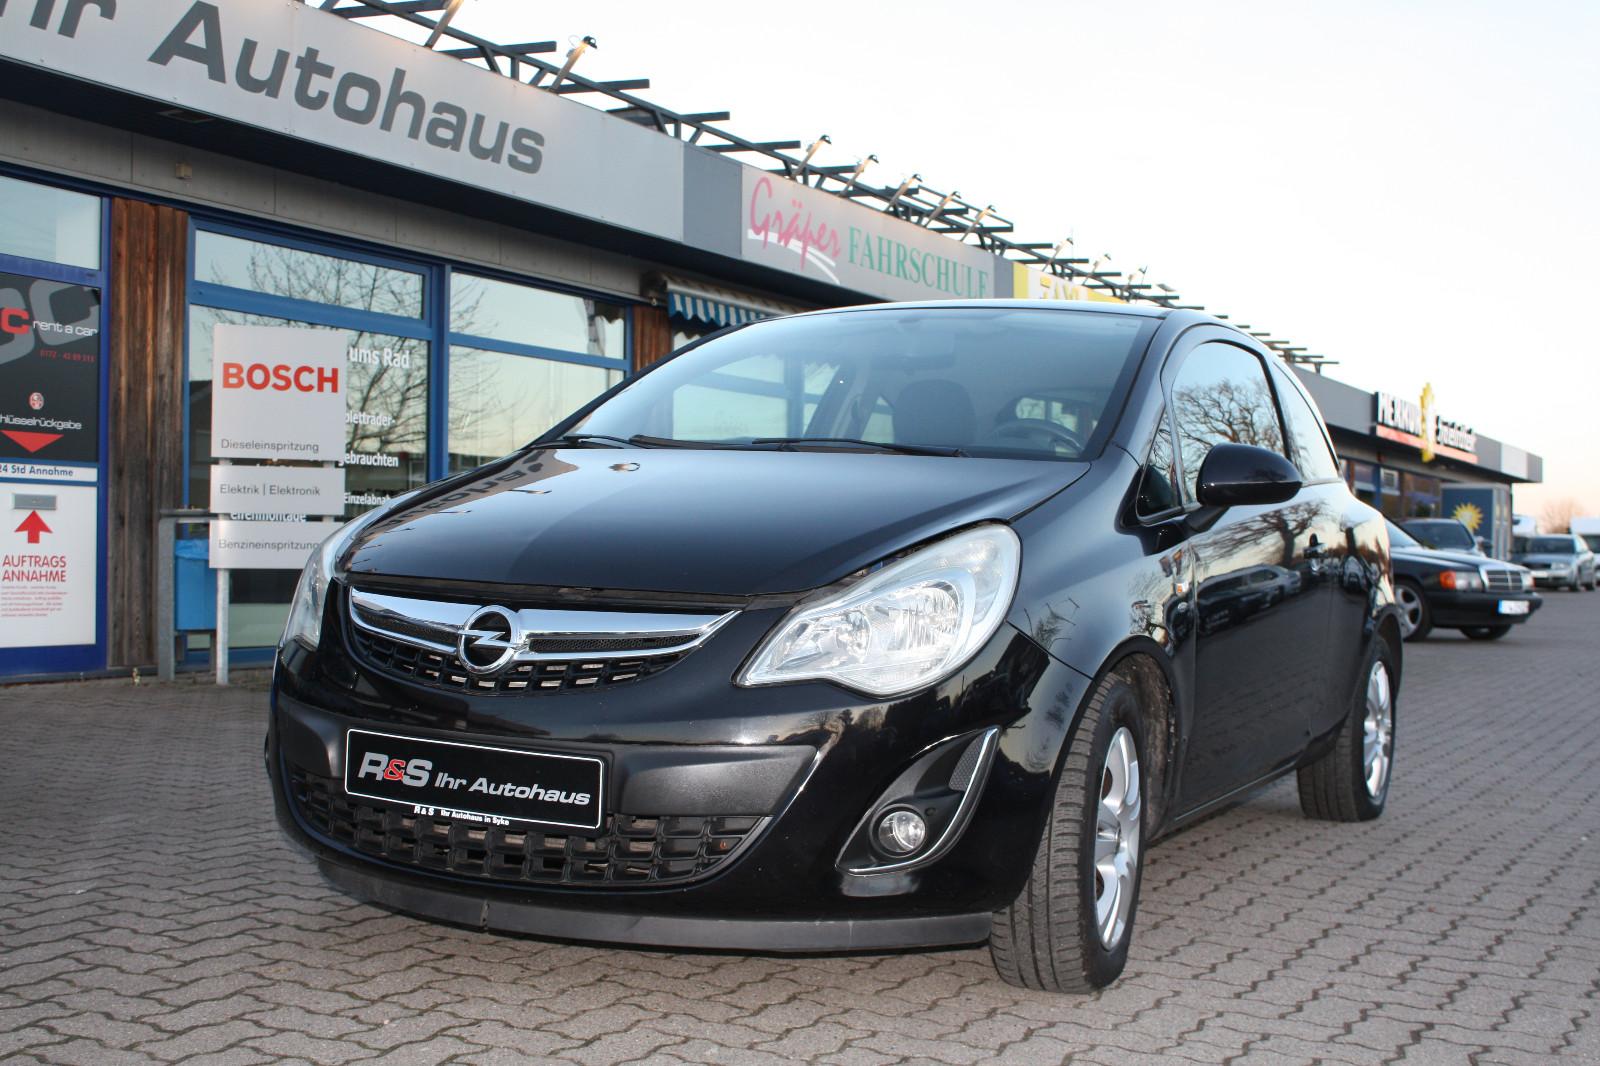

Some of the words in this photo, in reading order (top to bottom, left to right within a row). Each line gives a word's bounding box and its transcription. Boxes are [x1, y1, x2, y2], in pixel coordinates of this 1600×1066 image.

[147, 1, 545, 174] Autohaus
[750, 177, 841, 270] Gräper
[847, 226, 989, 299] FAHRSCHULE
[33, 319, 63, 333] rent
[64, 325, 73, 334] a
[75, 326, 98, 336] car
[349, 347, 380, 365] ums
[383, 347, 410, 368] Rad
[222, 362, 339, 393] BOSCH
[221, 438, 319, 454] Dieseleinspritzung
[338, 450, 399, 467] ebrauchten
[11, 464, 26, 474] Std
[30, 466, 74, 477] Annahme
[219, 484, 259, 495] Elektrik
[269, 485, 320, 496] Elektronik
[2, 554, 67, 569] AUFTRAGS
[2, 569, 67, 583] ANNAHME
[358, 751, 433, 788] R&S
[435, 771, 467, 790] Ihr
[468, 777, 591, 806] Autohaus
[413, 805, 420, 814] R
[428, 807, 434, 816] S
[440, 809, 450, 817] Ihr
[451, 811, 483, 822] Autohaus
[484, 815, 491, 823] in
[492, 816, 510, 826] Syke
